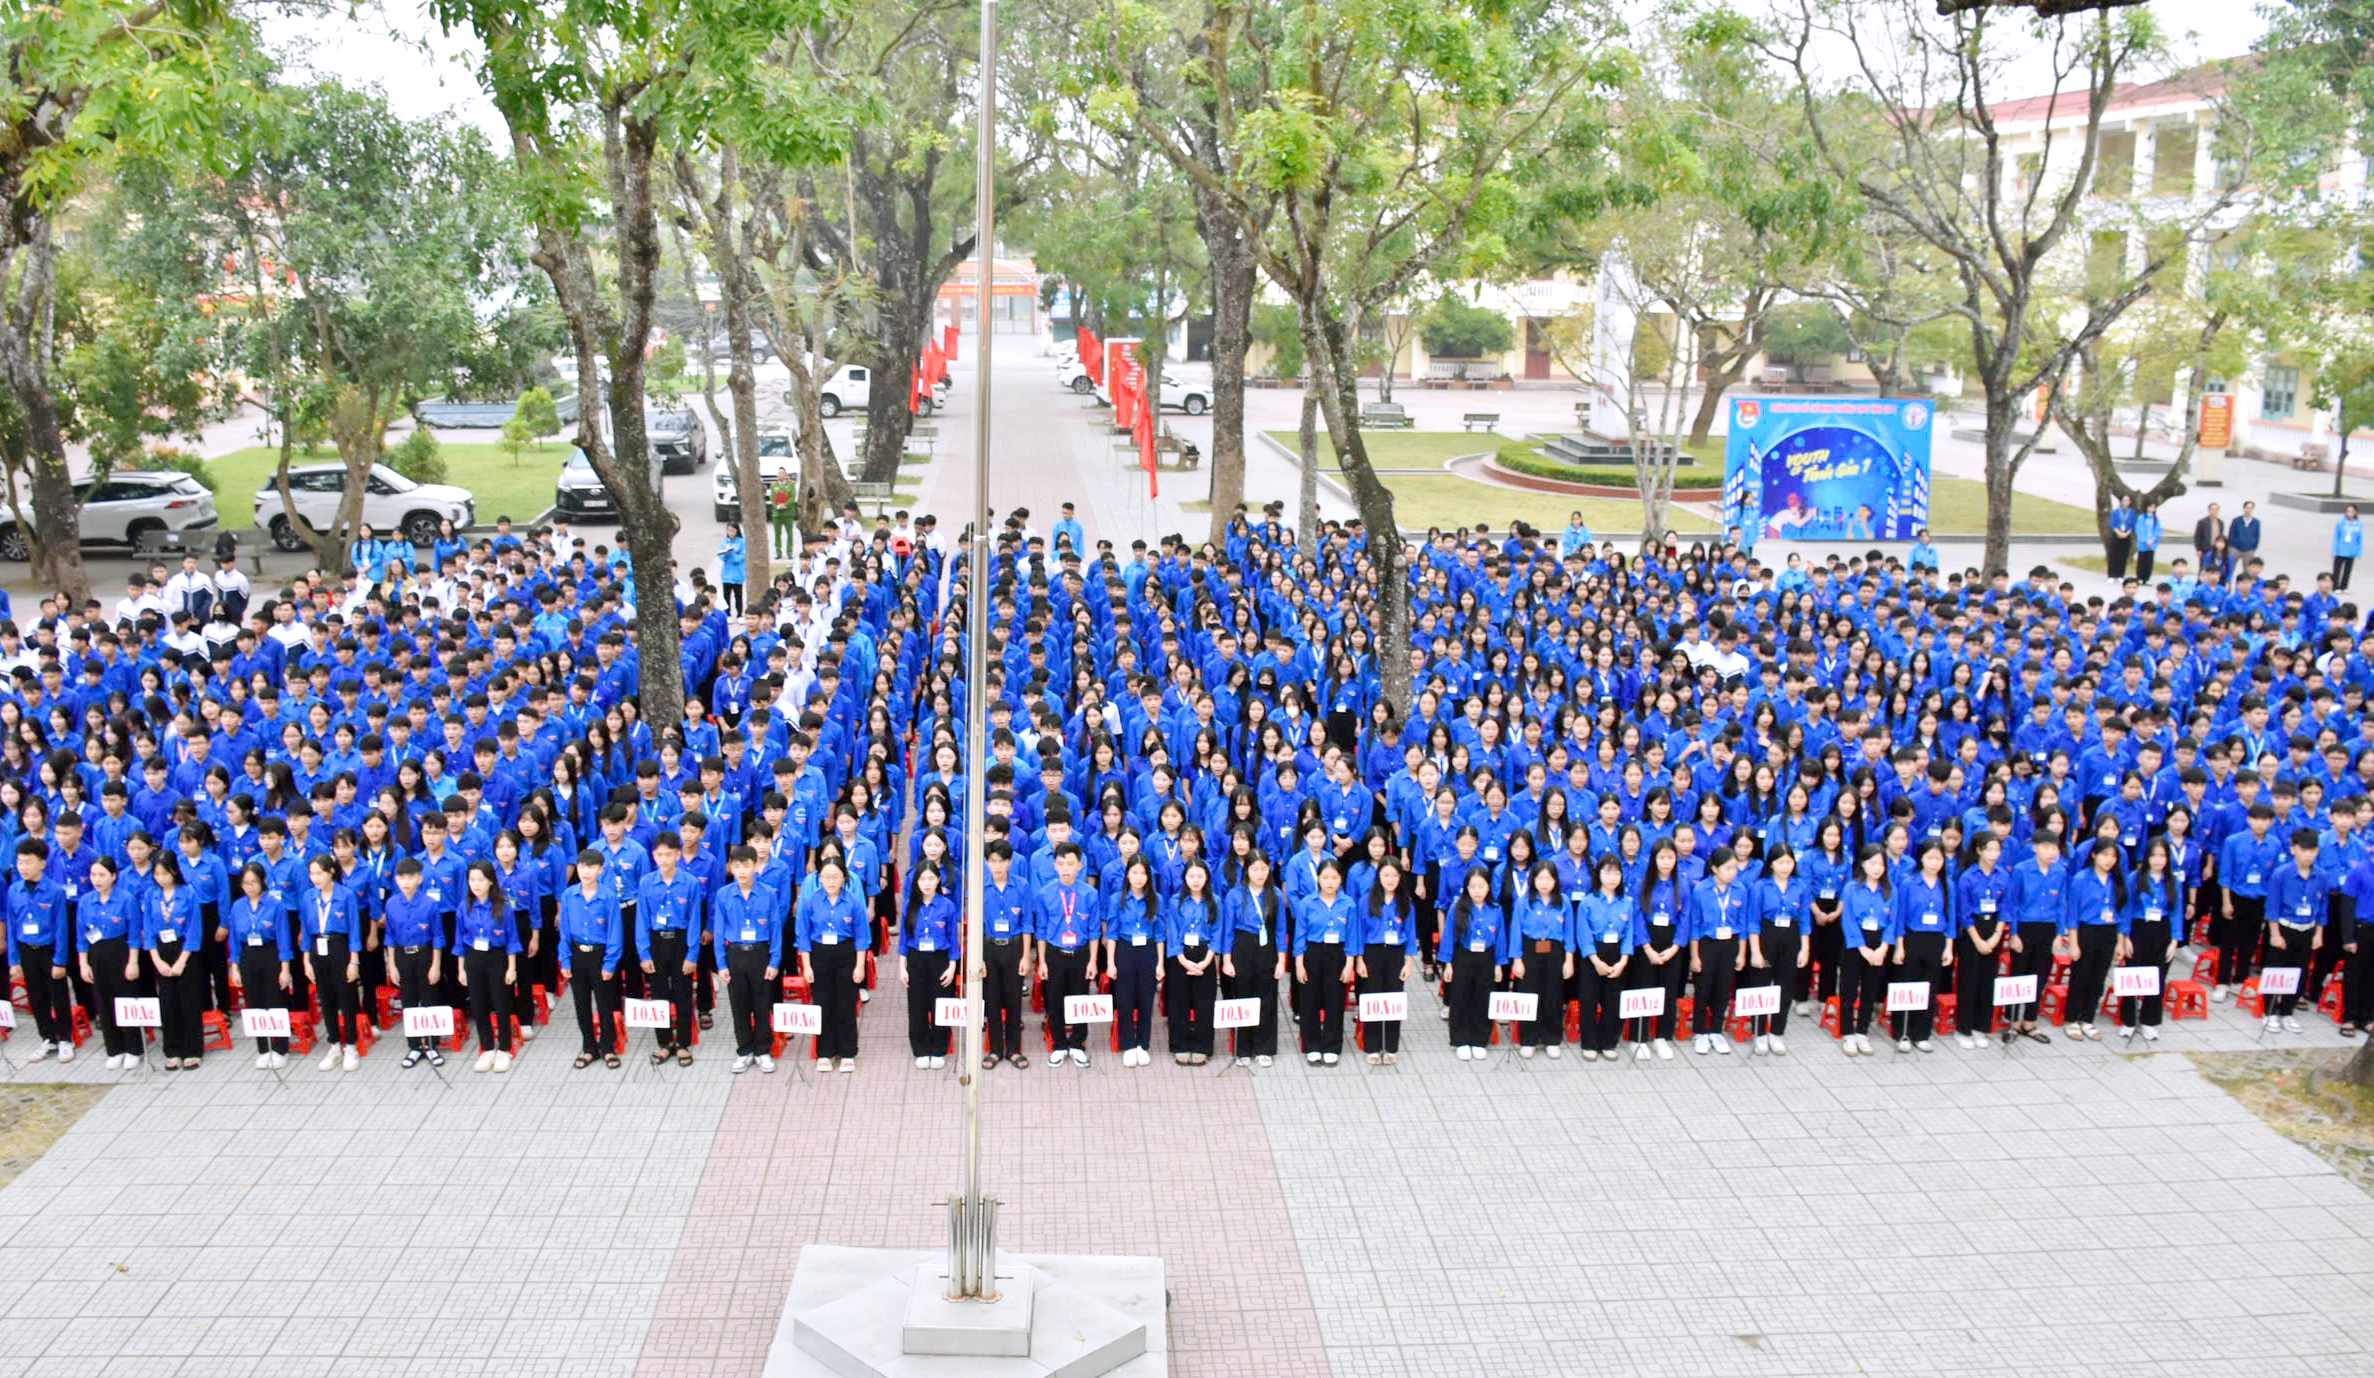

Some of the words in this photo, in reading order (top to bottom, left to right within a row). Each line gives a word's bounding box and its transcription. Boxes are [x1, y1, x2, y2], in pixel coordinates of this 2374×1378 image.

[1862, 458, 1872, 474] 1
[1073, 1001, 1107, 1017] 10A8
[1366, 999, 1402, 1015] 10A10
[1495, 999, 1531, 1015] 10A11
[1626, 995, 1660, 1011] 10A12
[123, 1004, 155, 1020] 10A2
[632, 1006, 666, 1022] 10A5
[782, 1011, 815, 1028] 10A6
[1221, 1005, 1250, 1021] 10A9
[251, 1015, 285, 1031] 10A3
[413, 1013, 447, 1030] 10A4
